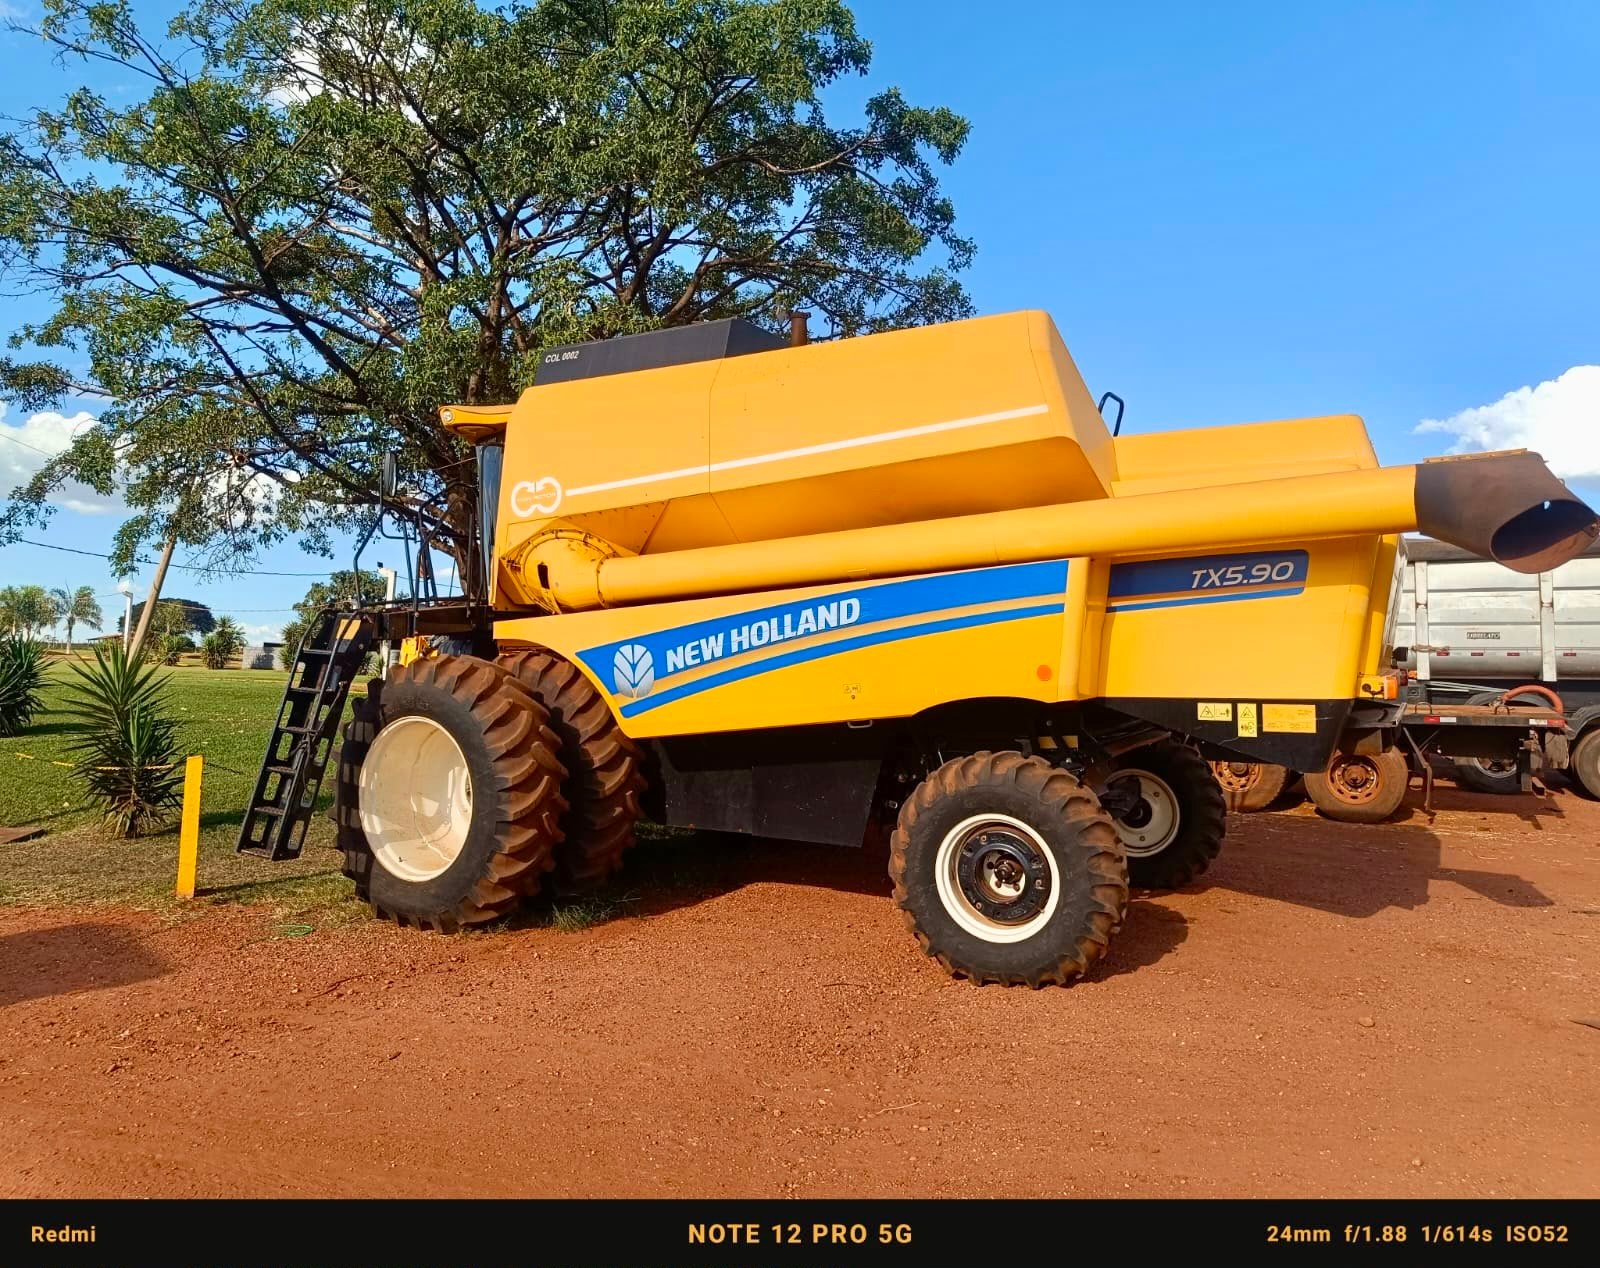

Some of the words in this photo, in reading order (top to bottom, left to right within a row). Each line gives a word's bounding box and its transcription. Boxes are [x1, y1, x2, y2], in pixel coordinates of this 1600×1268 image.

[545, 353, 560, 363] COL
[562, 350, 580, 361] 0002
[1191, 561, 1295, 589] TX5.90
[666, 632, 724, 673] NEW
[730, 597, 860, 653] HOLLAND
